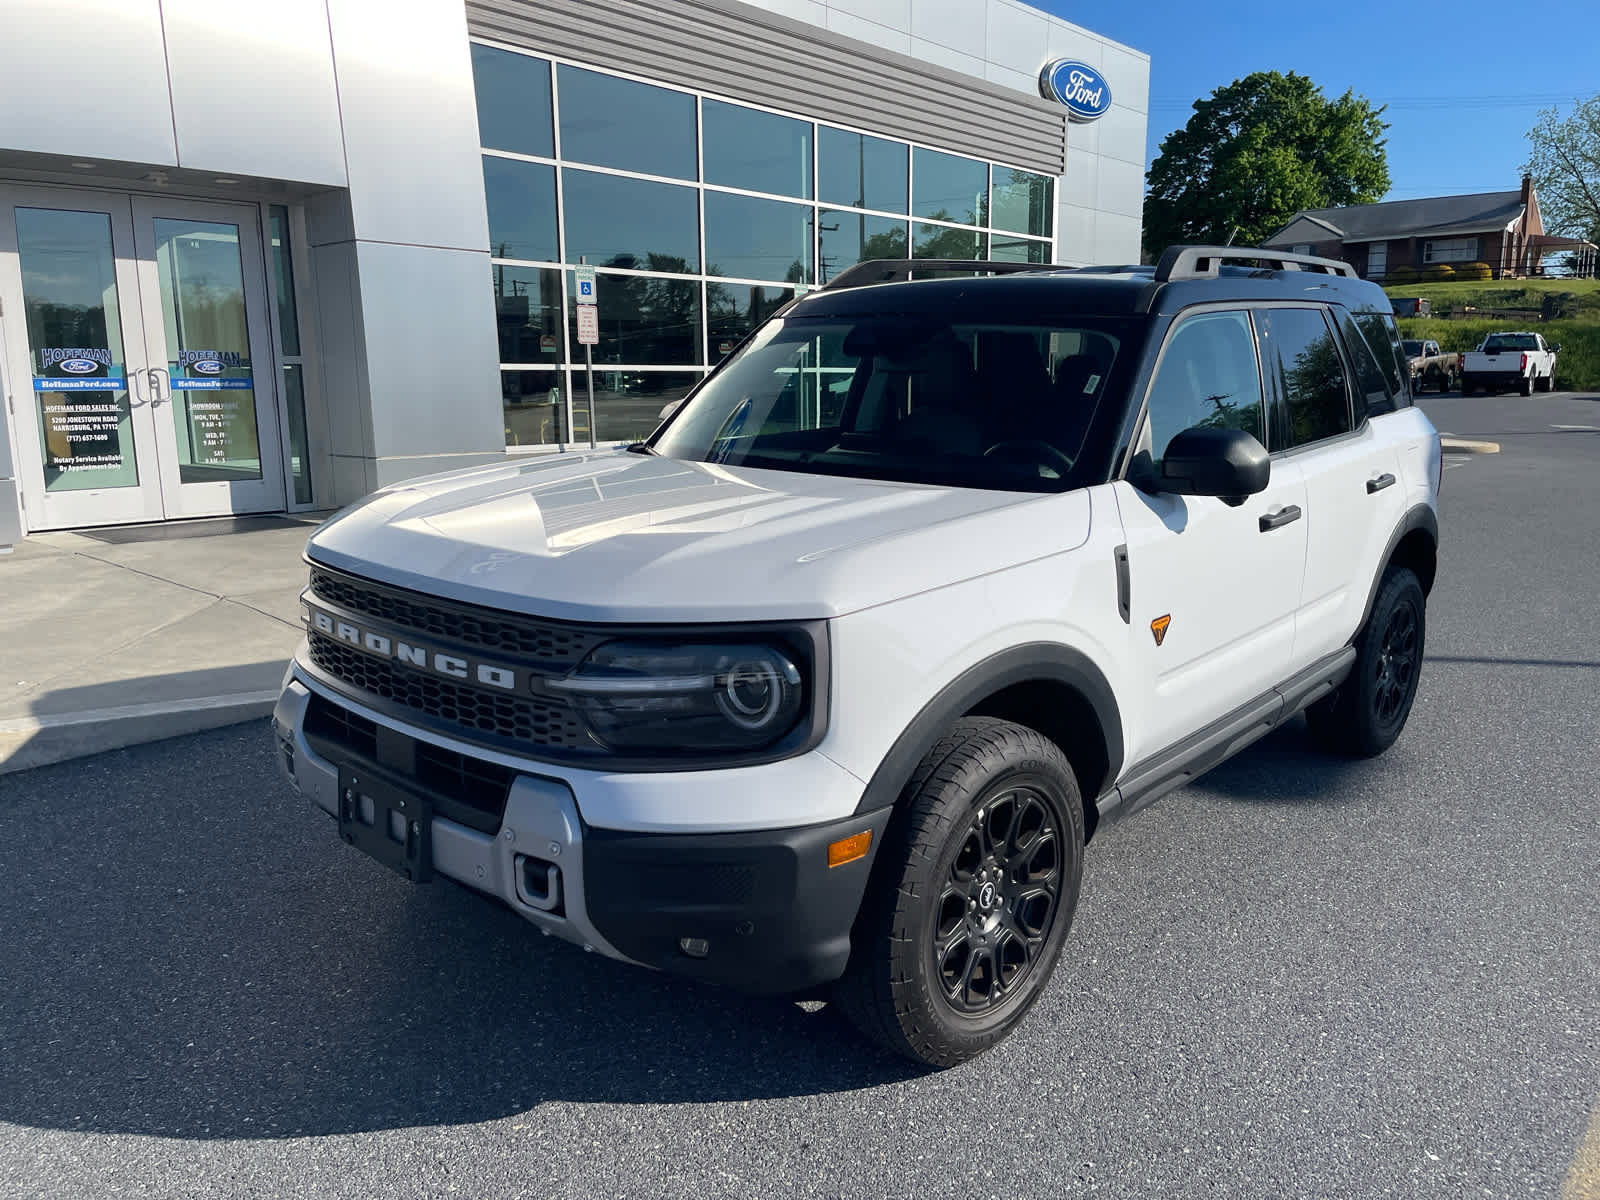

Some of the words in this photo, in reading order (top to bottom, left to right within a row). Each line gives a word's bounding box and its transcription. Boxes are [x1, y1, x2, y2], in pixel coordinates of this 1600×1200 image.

[1065, 70, 1103, 108] Ford
[41, 348, 113, 369] HOFFMAN
[178, 350, 241, 368] HOFFMAN
[69, 361, 90, 370] Ford
[41, 380, 120, 388] HoffmanFord.com
[75, 404, 91, 412] FORD
[91, 404, 109, 412] SALES
[67, 416, 102, 424] JONESTOWN
[53, 457, 75, 465] Notary
[68, 464, 107, 472] Appointment
[107, 463, 121, 471] Only
[314, 611, 515, 689] BRONCO
